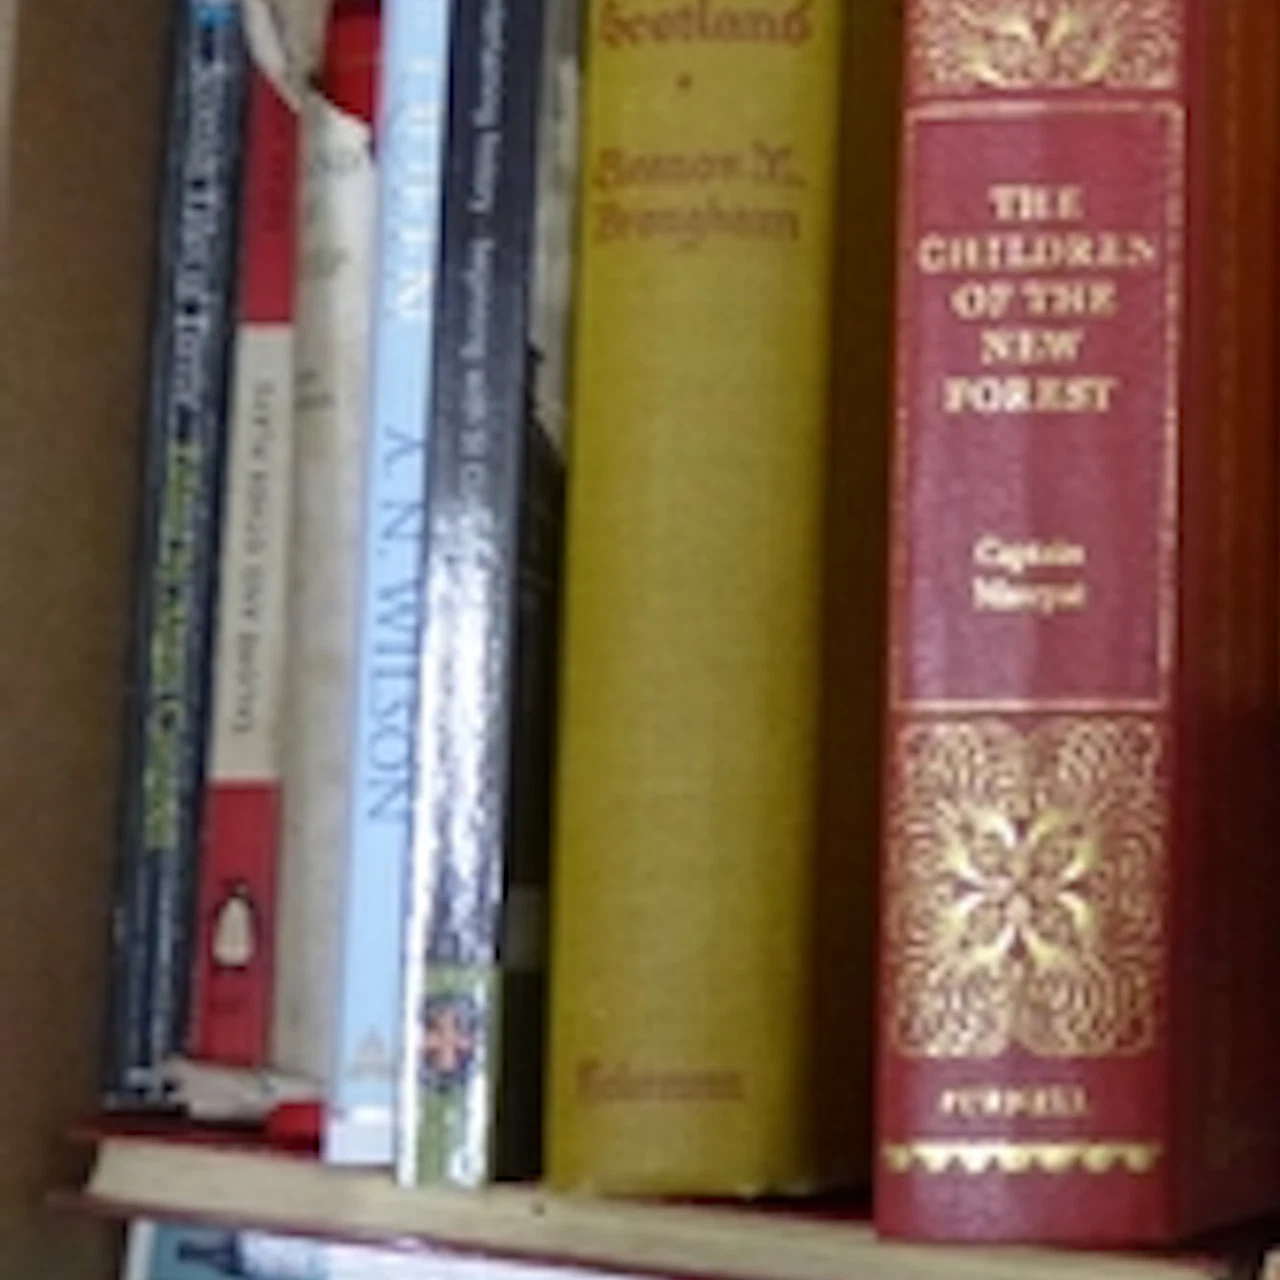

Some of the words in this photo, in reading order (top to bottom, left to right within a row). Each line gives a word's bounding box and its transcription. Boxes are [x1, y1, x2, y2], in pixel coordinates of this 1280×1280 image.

[987, 183, 1085, 223] THE
[917, 231, 1156, 276] CHILDREN
[950, 282, 1013, 321] OF
[1021, 280, 1118, 319] THE
[980, 327, 1086, 366] NEW
[944, 375, 1120, 413] FOREST
[364, 584, 418, 827] WILSON
